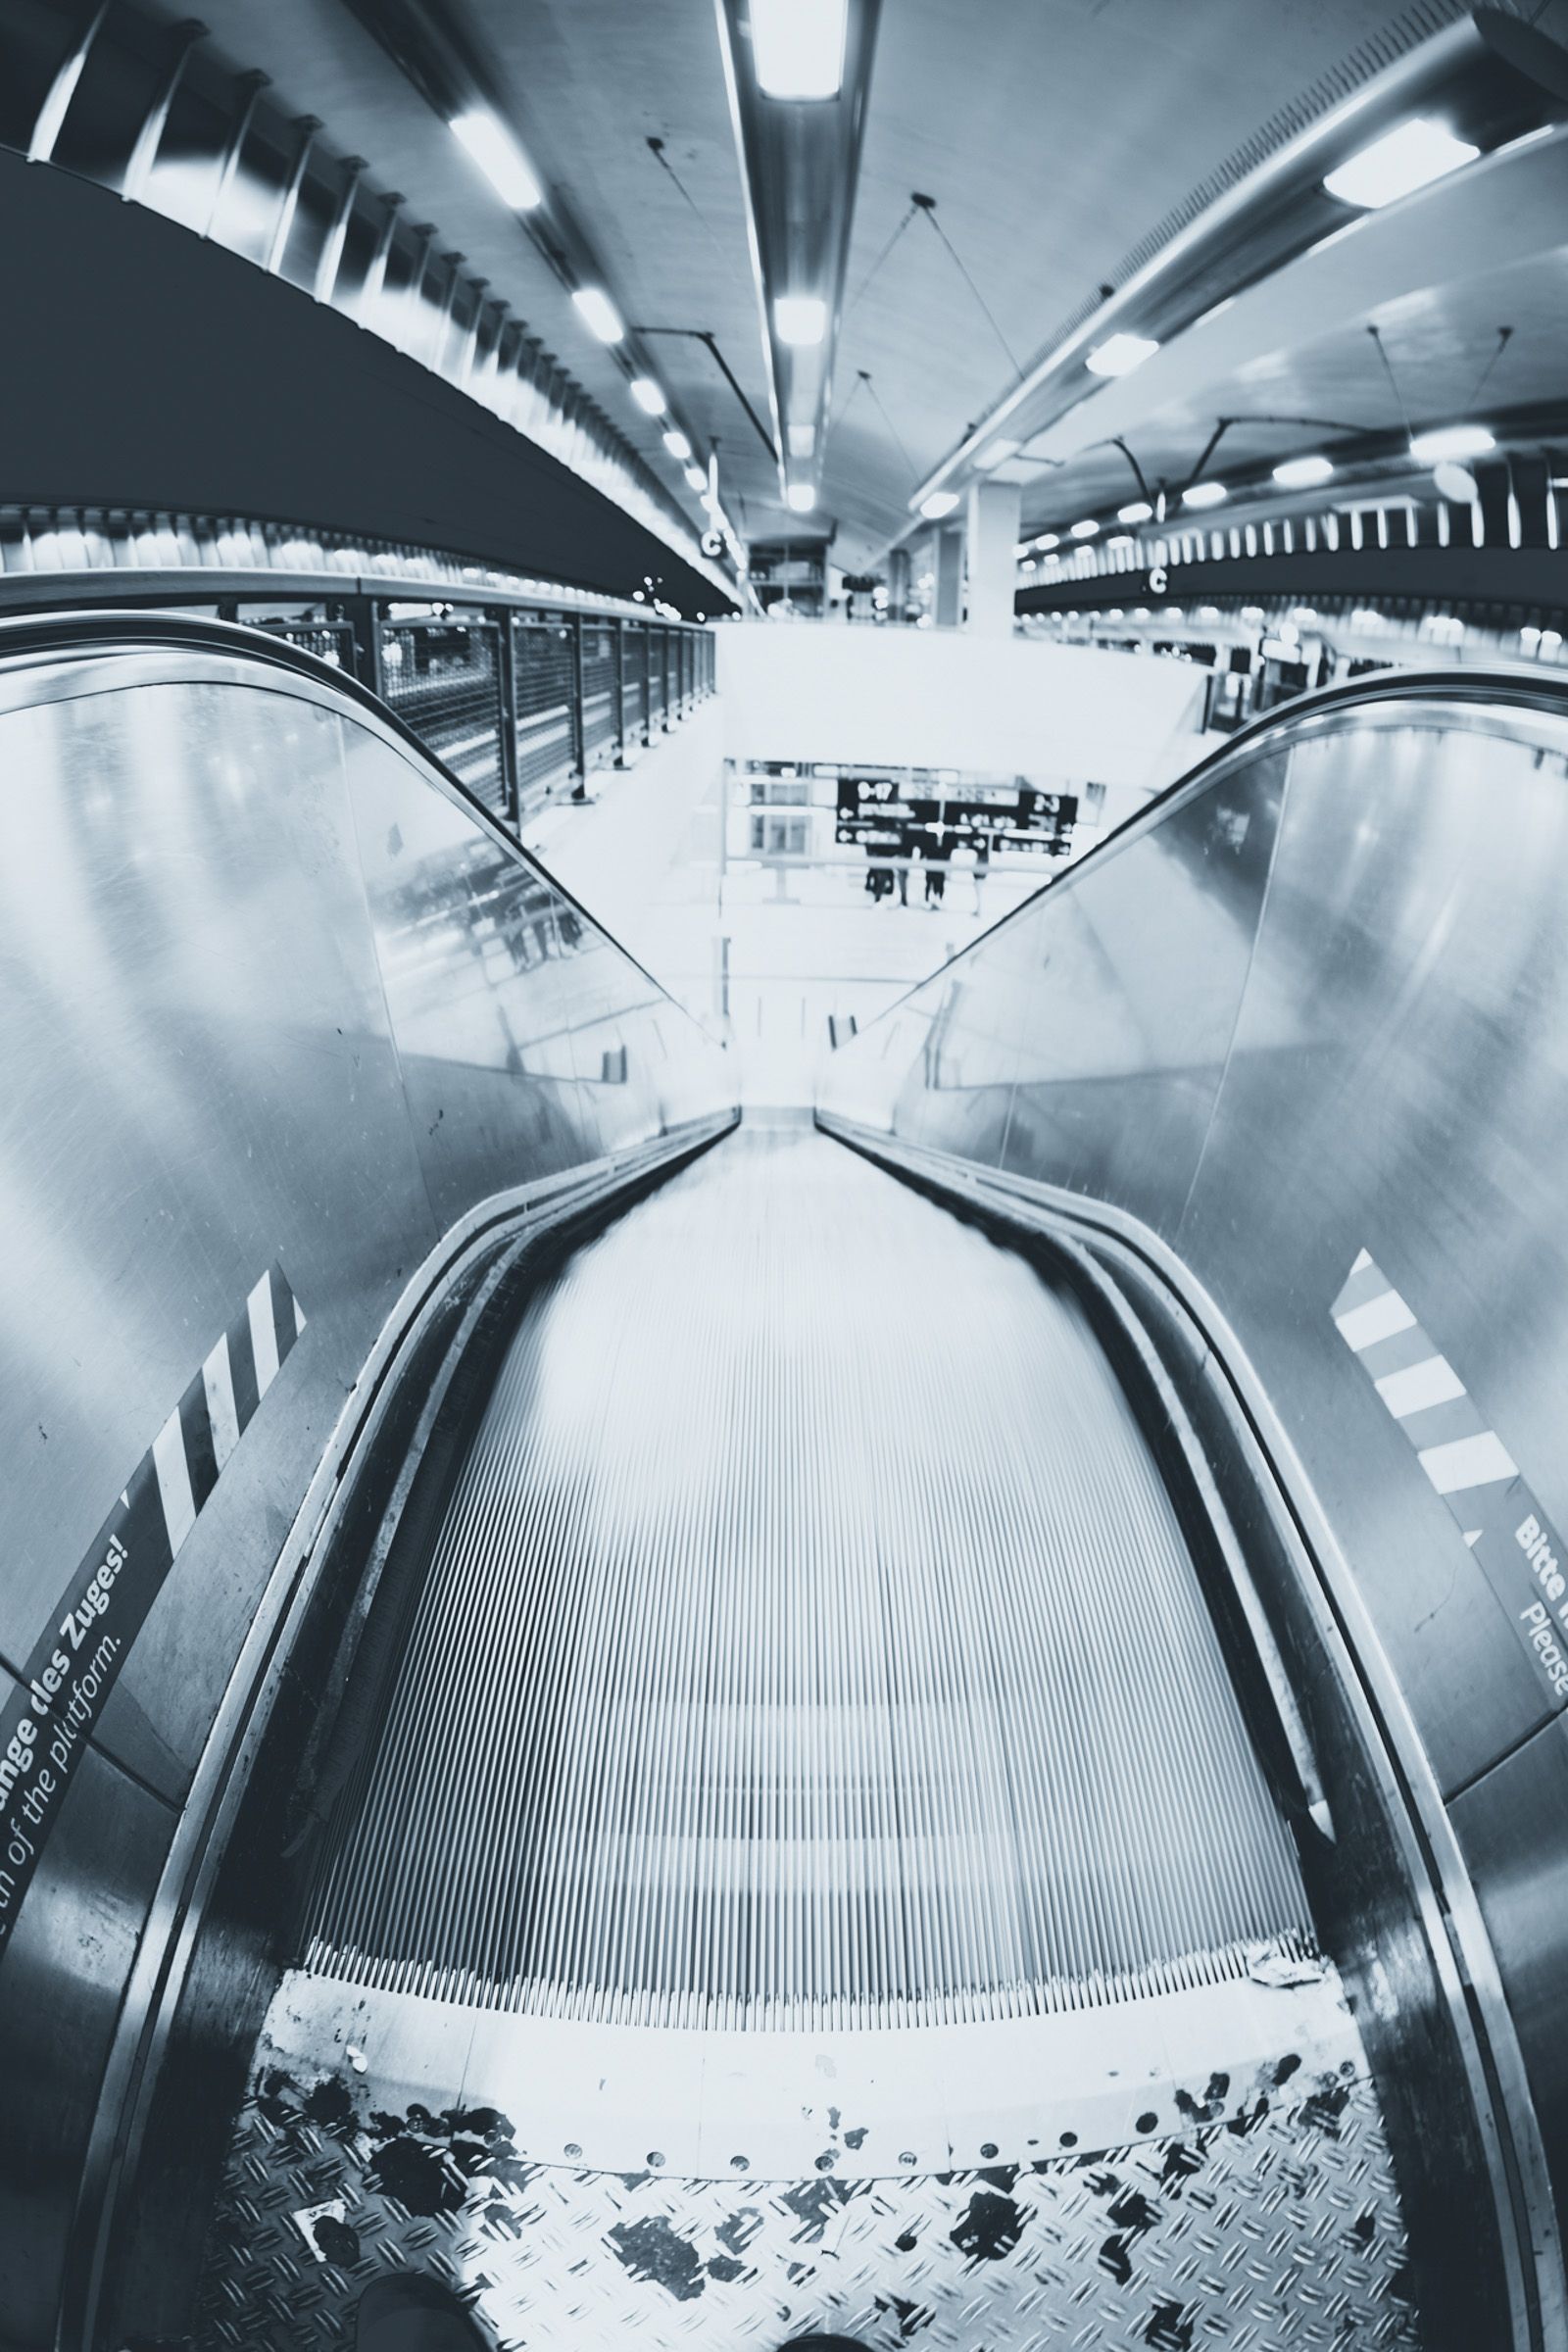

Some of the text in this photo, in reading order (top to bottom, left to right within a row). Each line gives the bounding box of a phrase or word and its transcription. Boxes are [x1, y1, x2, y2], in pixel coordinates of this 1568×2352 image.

[701, 531, 722, 557] C
[1150, 567, 1168, 595] C
[1515, 1513, 1566, 1601] Bitte
[30, 1648, 71, 1716] des
[59, 1534, 128, 1651] Zuges!
[1519, 1600, 1568, 1697] Please
[8, 1818, 35, 1866] of
[22, 1769, 56, 1836] the
[49, 1635, 122, 1775] platform.
